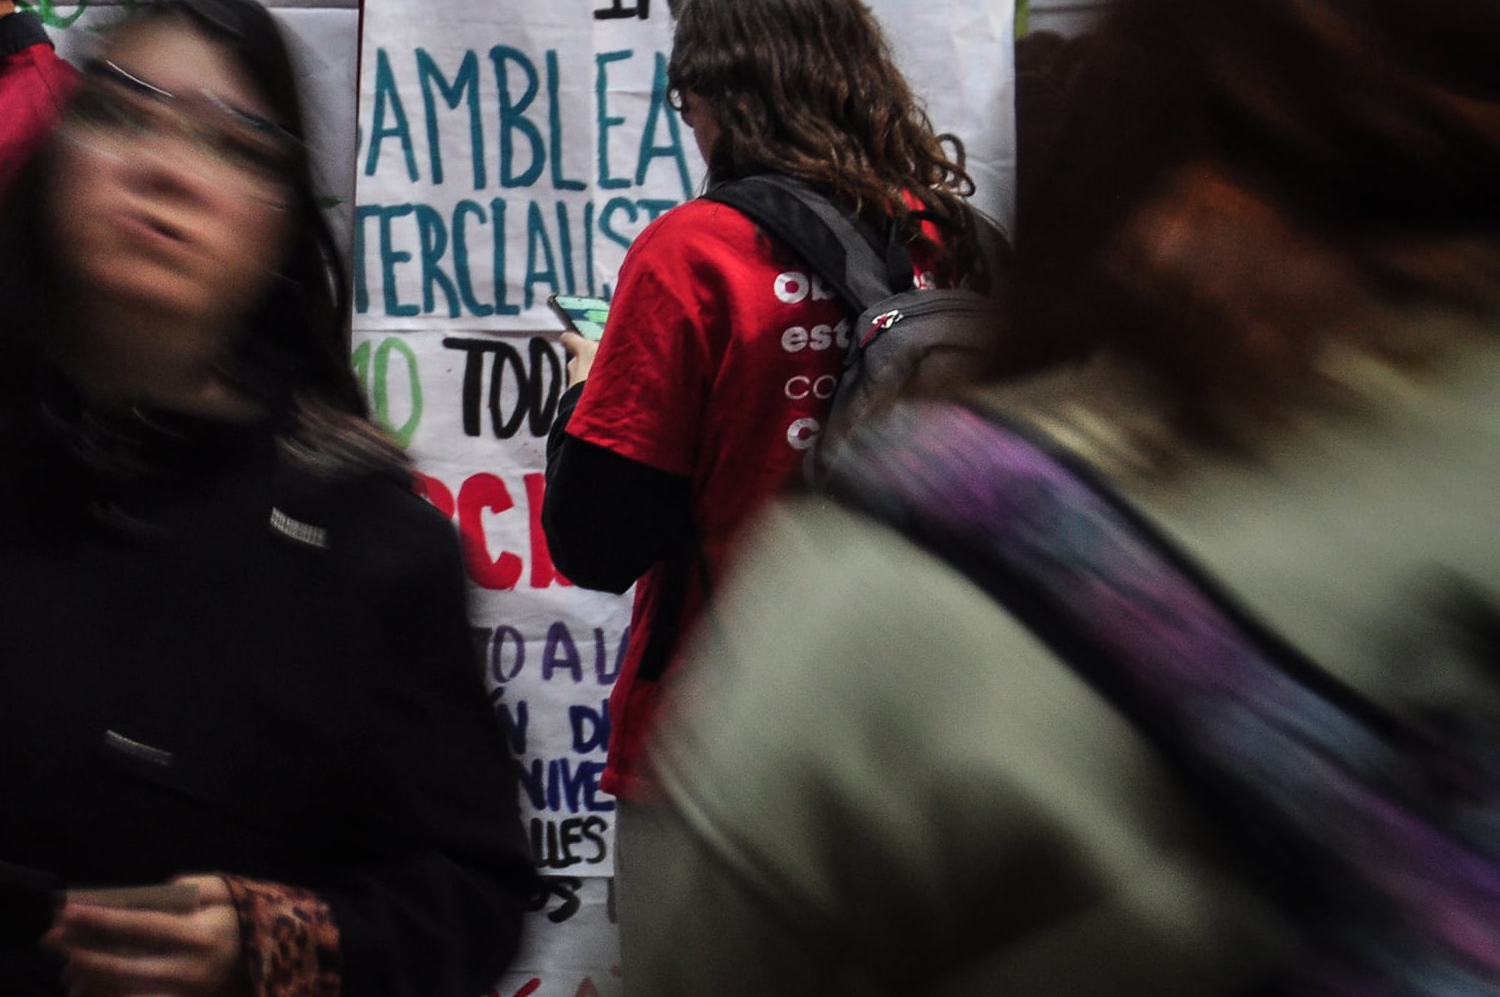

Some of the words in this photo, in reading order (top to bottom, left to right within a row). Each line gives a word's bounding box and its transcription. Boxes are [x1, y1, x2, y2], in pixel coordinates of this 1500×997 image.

[359, 44, 695, 201] AMBLEA
[443, 336, 570, 441] TOD
[542, 620, 583, 684] A
[568, 698, 611, 754] D
[530, 815, 609, 870] LLES
